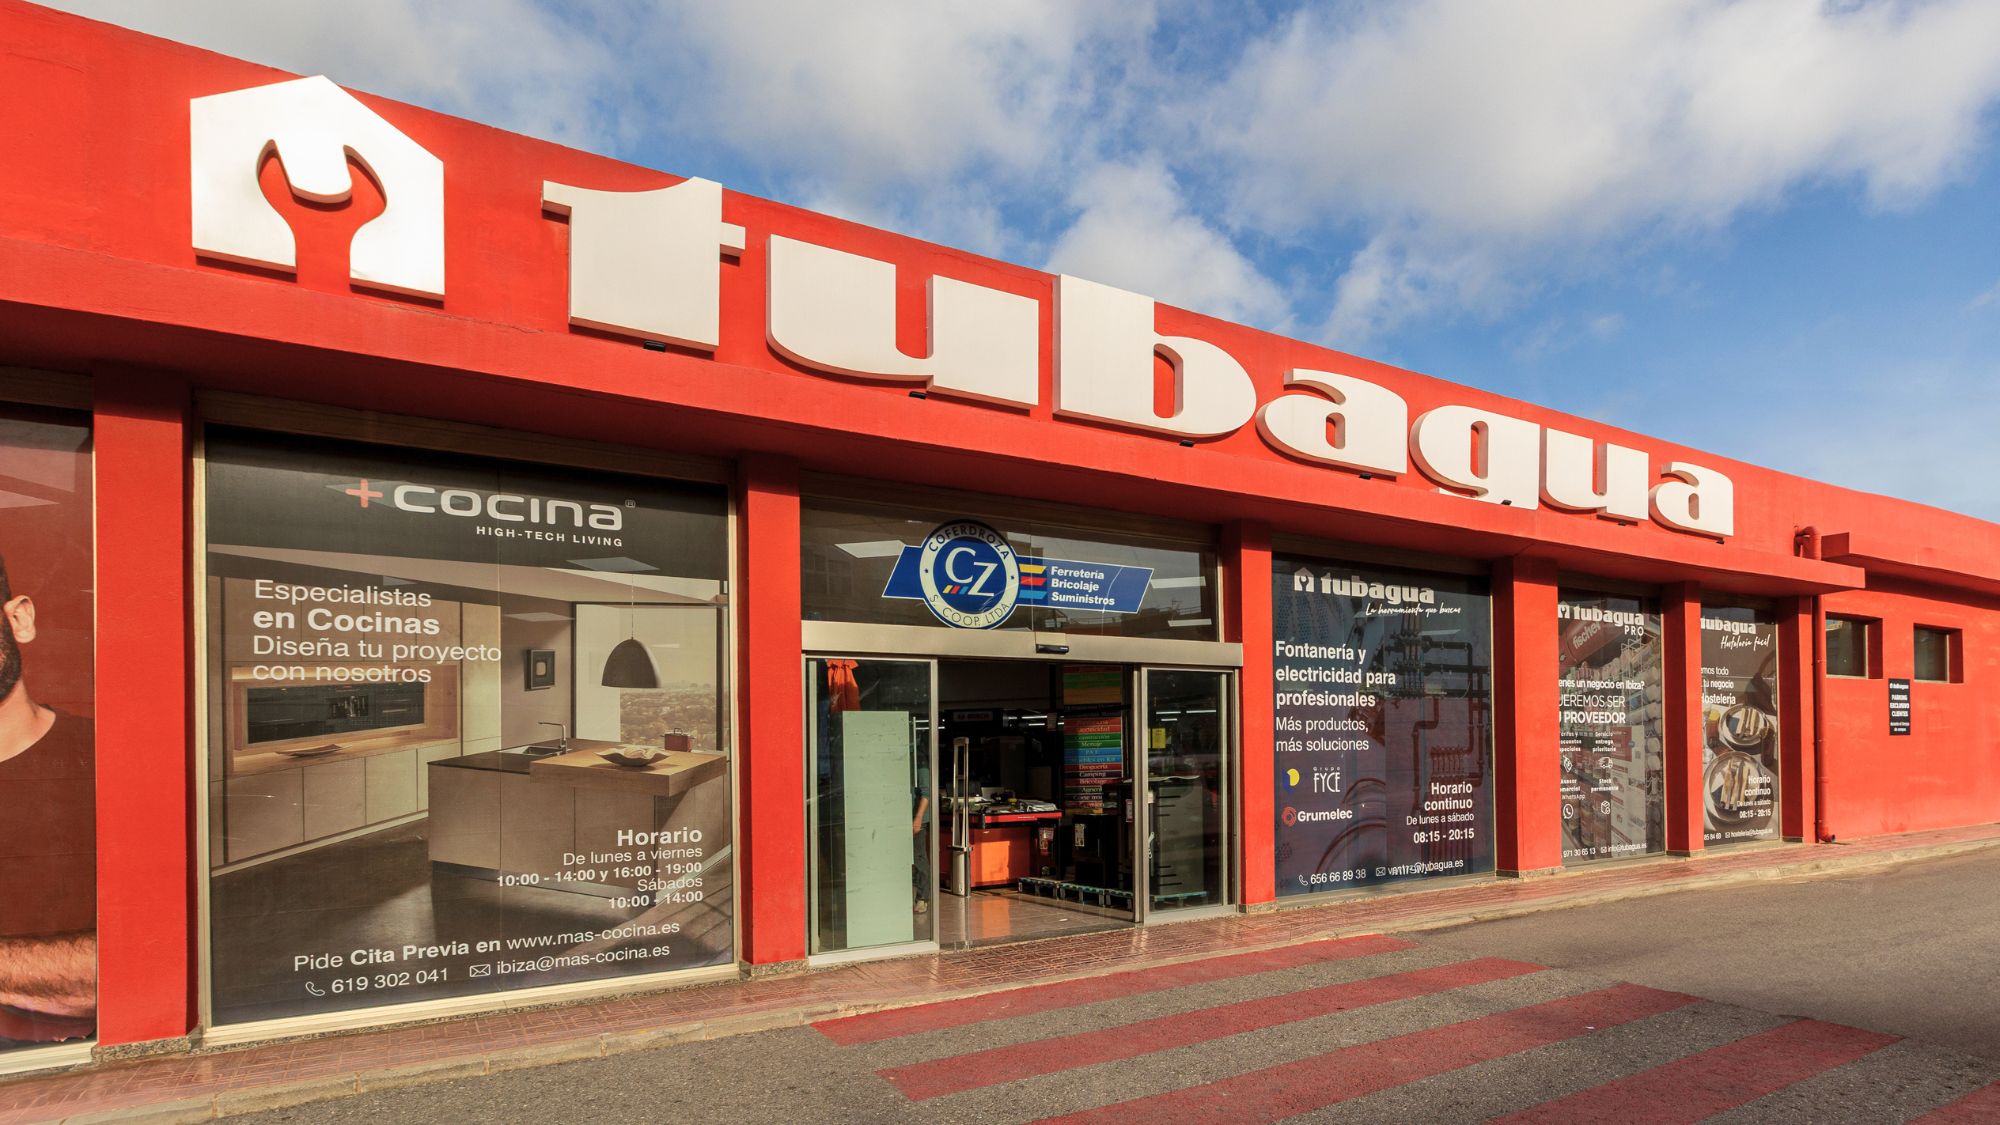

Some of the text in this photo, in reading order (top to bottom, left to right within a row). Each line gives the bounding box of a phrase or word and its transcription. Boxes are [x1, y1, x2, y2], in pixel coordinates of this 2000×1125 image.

[542, 177, 1734, 538] tubagua
[476, 526, 623, 547] HIGH-TECH LIVING
[928, 524, 1010, 560] COFERDROZA
[945, 547, 998, 597] CZ
[1051, 565, 1104, 580] Ferretería
[254, 579, 431, 608] Especialistas
[1051, 578, 1100, 592] Bricolaje
[1321, 572, 1435, 604] tubagua
[1051, 591, 1115, 606] Suministros
[984, 602, 1012, 625] LTDA.
[1365, 602, 1461, 618] La herramienta que buscas
[1573, 604, 1645, 626] tubagua
[252, 608, 440, 635] en Cocinas
[1624, 625, 1645, 636] PRO
[253, 635, 502, 663] Diseña tu proyecto
[1275, 640, 1366, 664] Fontanería y
[252, 663, 431, 683] con nosotros
[1275, 665, 1396, 687] electricidad para
[1716, 666, 1729, 675] todo
[1576, 680, 1586, 688] un
[1587, 680, 1615, 690] negocio
[1616, 681, 1625, 689] en
[1626, 680, 1645, 690] Ibiza?
[1710, 680, 1734, 690] negocio
[1276, 691, 1376, 709] profesionales
[1607, 696, 1625, 707] SER
[1275, 716, 1369, 733] Más productos,
[1564, 711, 1626, 724] PROVEEDOR
[1276, 737, 1369, 752] más soluciones
[1313, 772, 1341, 793] FYCE
[1431, 781, 1473, 795] Horario
[1748, 775, 1771, 784] Horario
[1744, 787, 1771, 796] continuo
[1424, 797, 1473, 812] continuo
[1297, 808, 1353, 822] Grumelec
[1406, 815, 1417, 825] De
[1419, 814, 1439, 824] lunes
[1447, 811, 1475, 823] sábado
[616, 827, 703, 847] Horario
[1413, 830, 1440, 844] 08:15
[1448, 828, 1475, 841] 20:15
[563, 845, 703, 867] De lunes a viernes
[497, 872, 540, 887] 10:00
[554, 868, 595, 883] 14:00
[599, 870, 609, 882] y
[611, 865, 652, 879] 16:00
[665, 861, 703, 876] 19:00
[637, 874, 703, 892] Sábados
[1310, 873, 1327, 885] 656
[1329, 872, 1340, 883] 66
[1342, 870, 1353, 881] 89
[1355, 868, 1367, 880] 38
[608, 895, 649, 910] 10:00
[663, 890, 703, 905] 14:00
[294, 921, 680, 972] Pide Cita Previa en www.mas-cocina.es
[331, 944, 671, 995] 619 302 041 ibiza@mas-cocina.es
